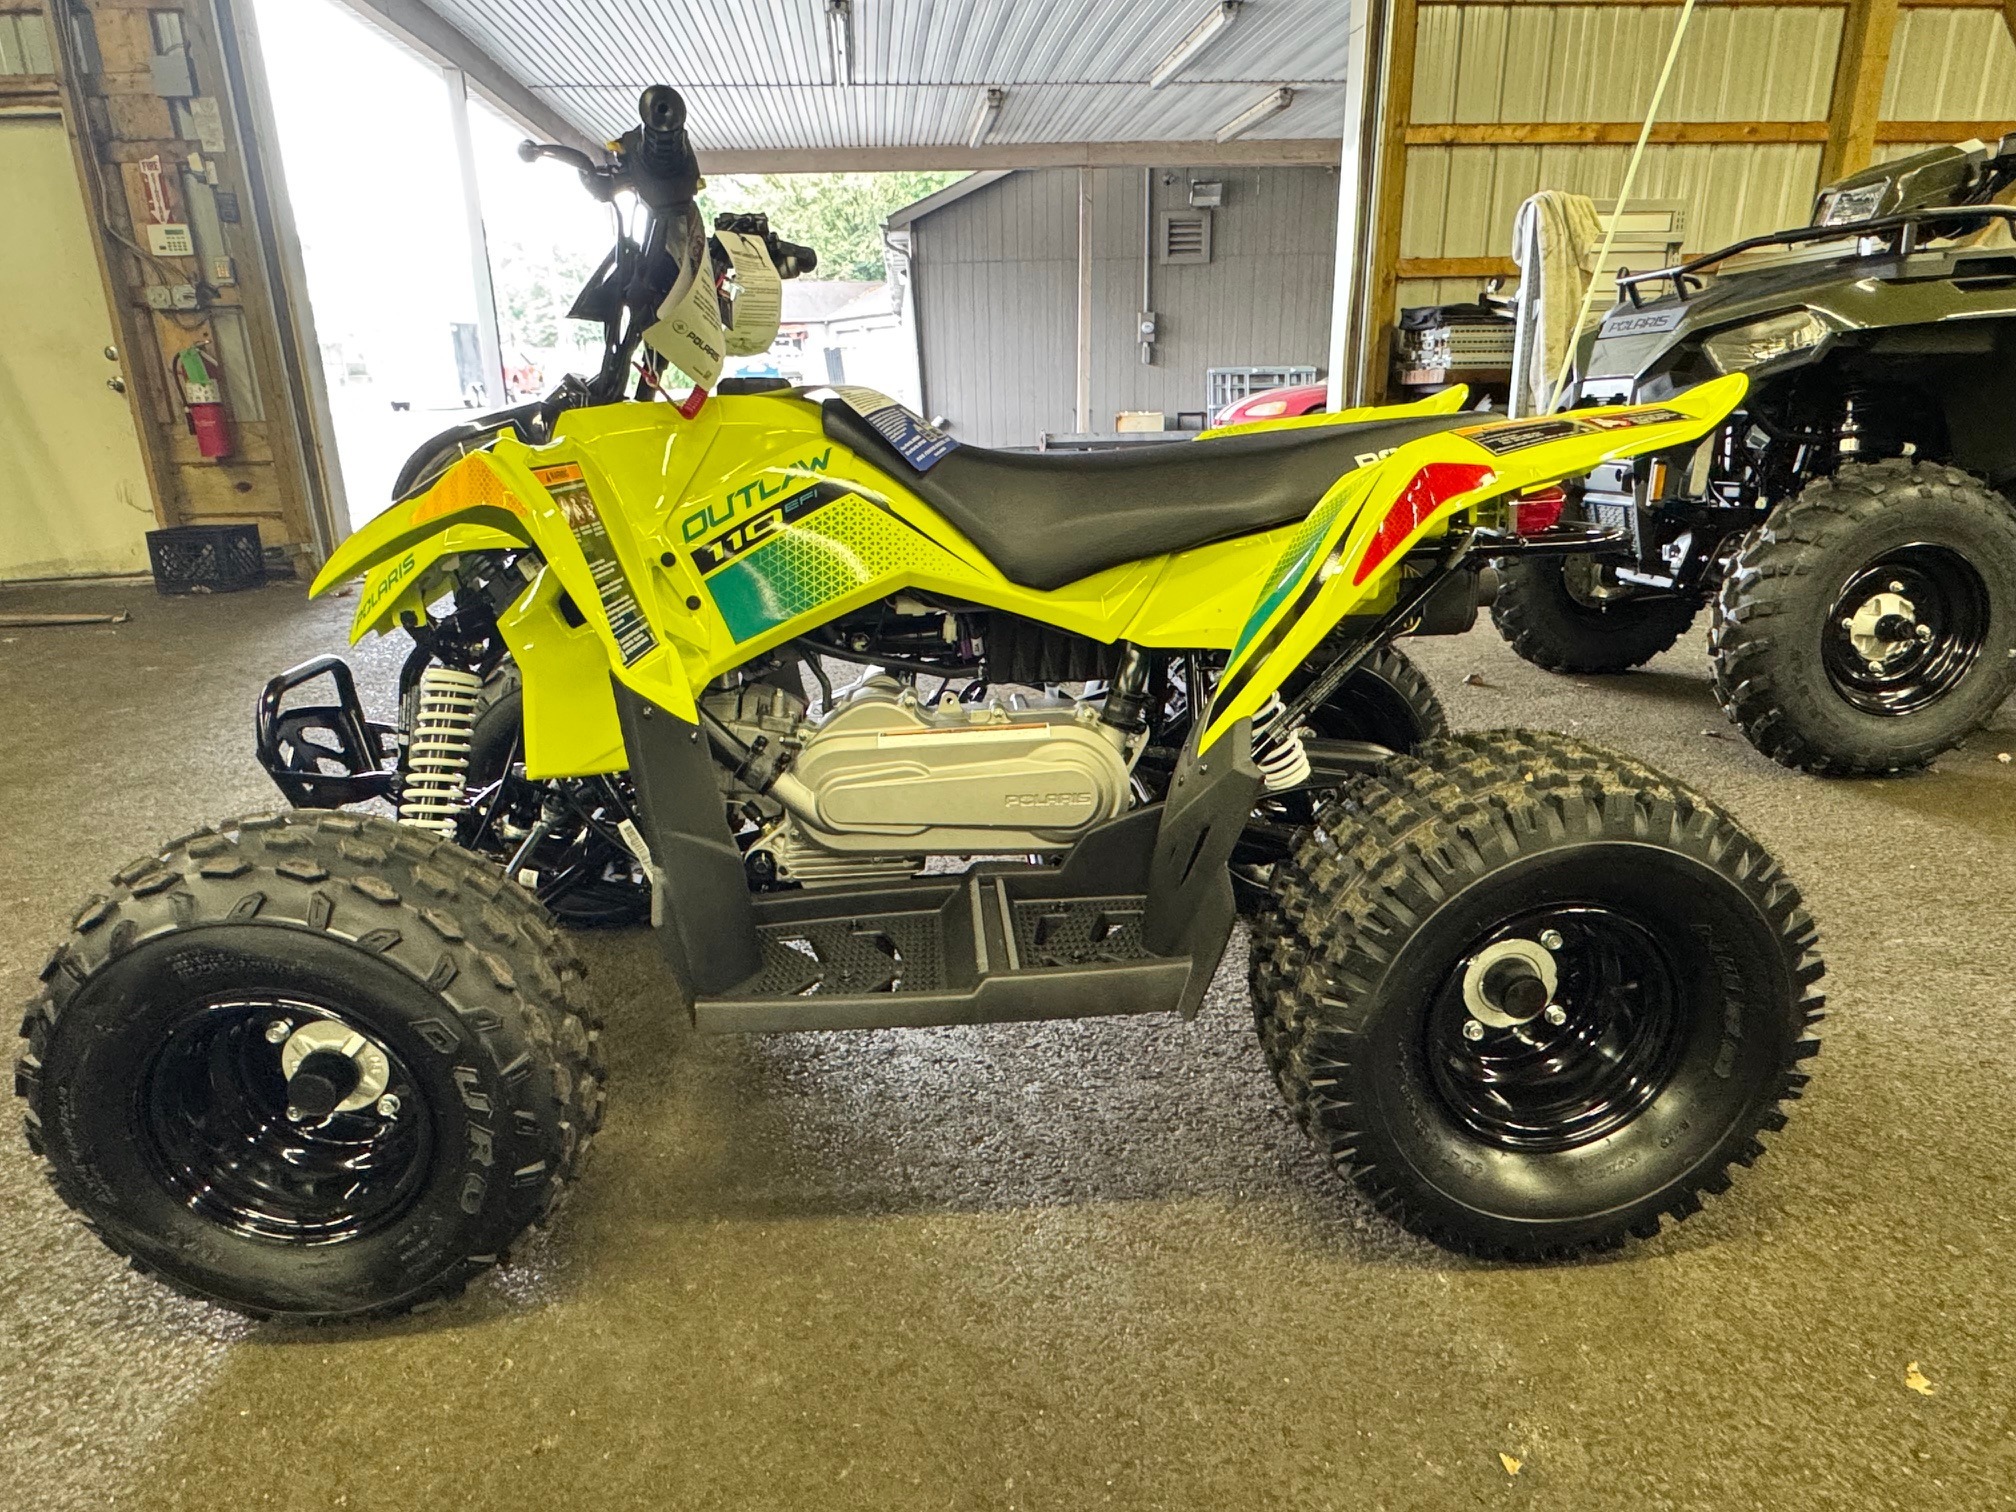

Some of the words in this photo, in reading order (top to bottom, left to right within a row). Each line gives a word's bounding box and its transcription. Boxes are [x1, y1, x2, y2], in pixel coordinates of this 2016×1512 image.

[686, 331, 721, 363] POLARIS
[1609, 314, 1670, 333] POLARIS
[682, 447, 832, 544] OUTLAW
[708, 508, 783, 563] 110
[784, 489, 818, 513] EFI
[356, 552, 415, 630] POLARIS
[1005, 791, 1092, 808] POLARIS
[408, 1017, 495, 1215] DURO
